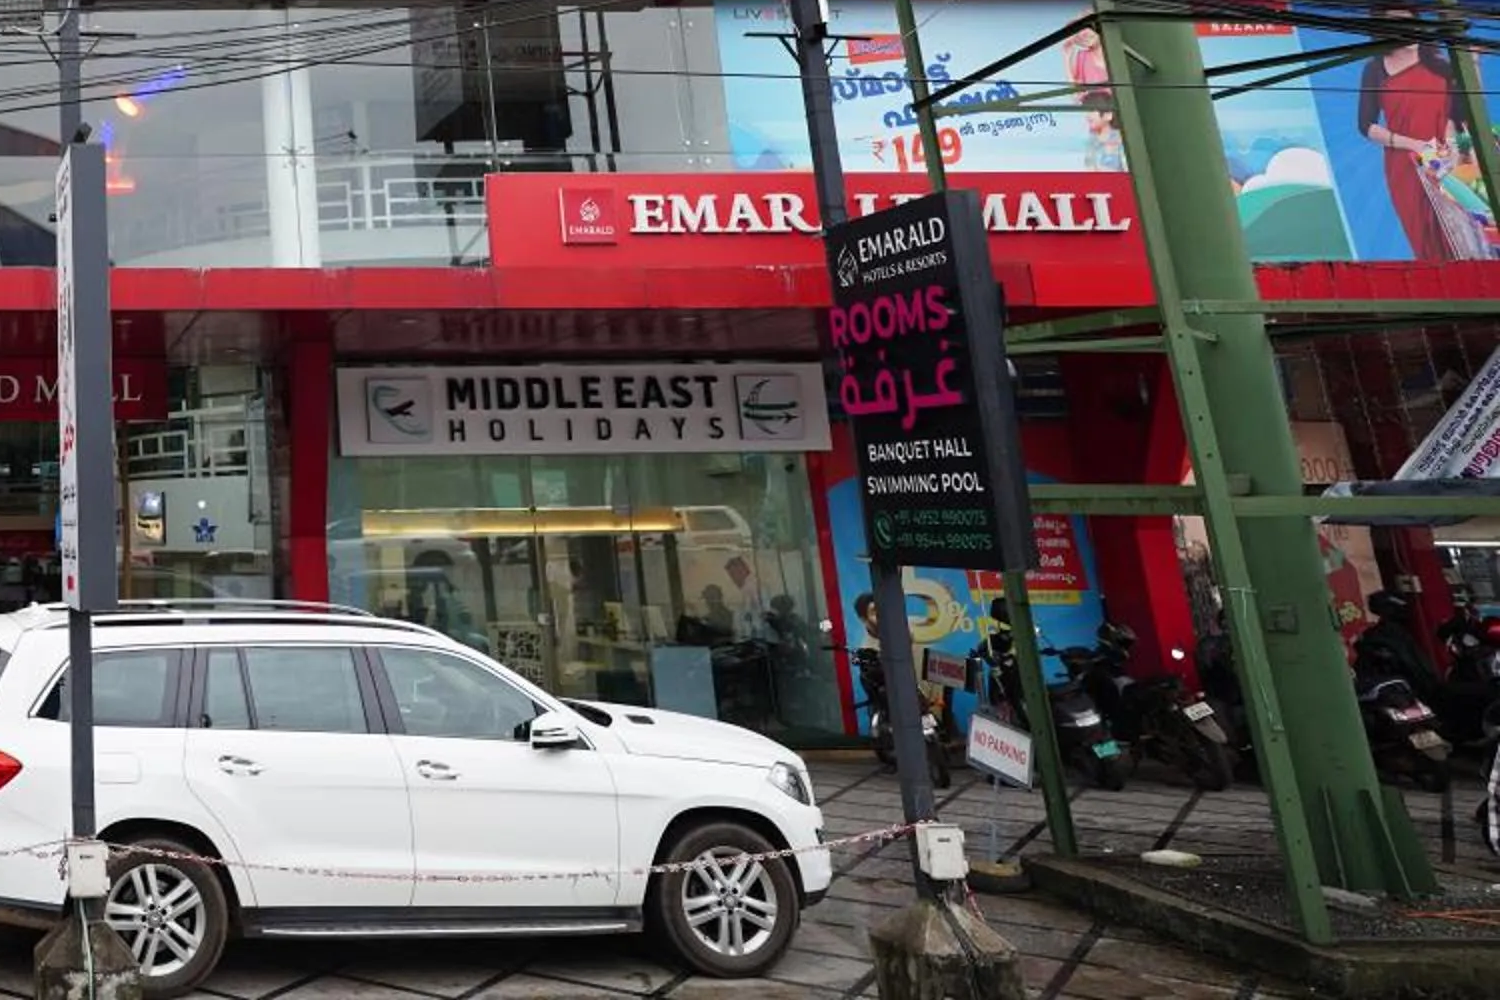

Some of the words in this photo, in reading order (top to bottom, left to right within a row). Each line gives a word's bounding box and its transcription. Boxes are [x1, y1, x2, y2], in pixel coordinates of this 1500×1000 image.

[858, 217, 946, 263] EMARALD
[863, 261, 897, 283] HOTELS
[903, 251, 947, 274] RESORTS
[829, 285, 951, 349] ROOMS
[34, 375, 142, 404] ML
[445, 377, 604, 412] MIDDLE
[614, 375, 719, 411] EAST
[840, 340, 963, 431] غرفة
[448, 417, 726, 443] HOLIDAYS
[868, 439, 931, 462] BANQUET
[933, 437, 973, 459] HALL
[867, 473, 939, 495] SWIMMING
[941, 471, 985, 493] POOL
[987, 734, 1027, 766] PARKING
